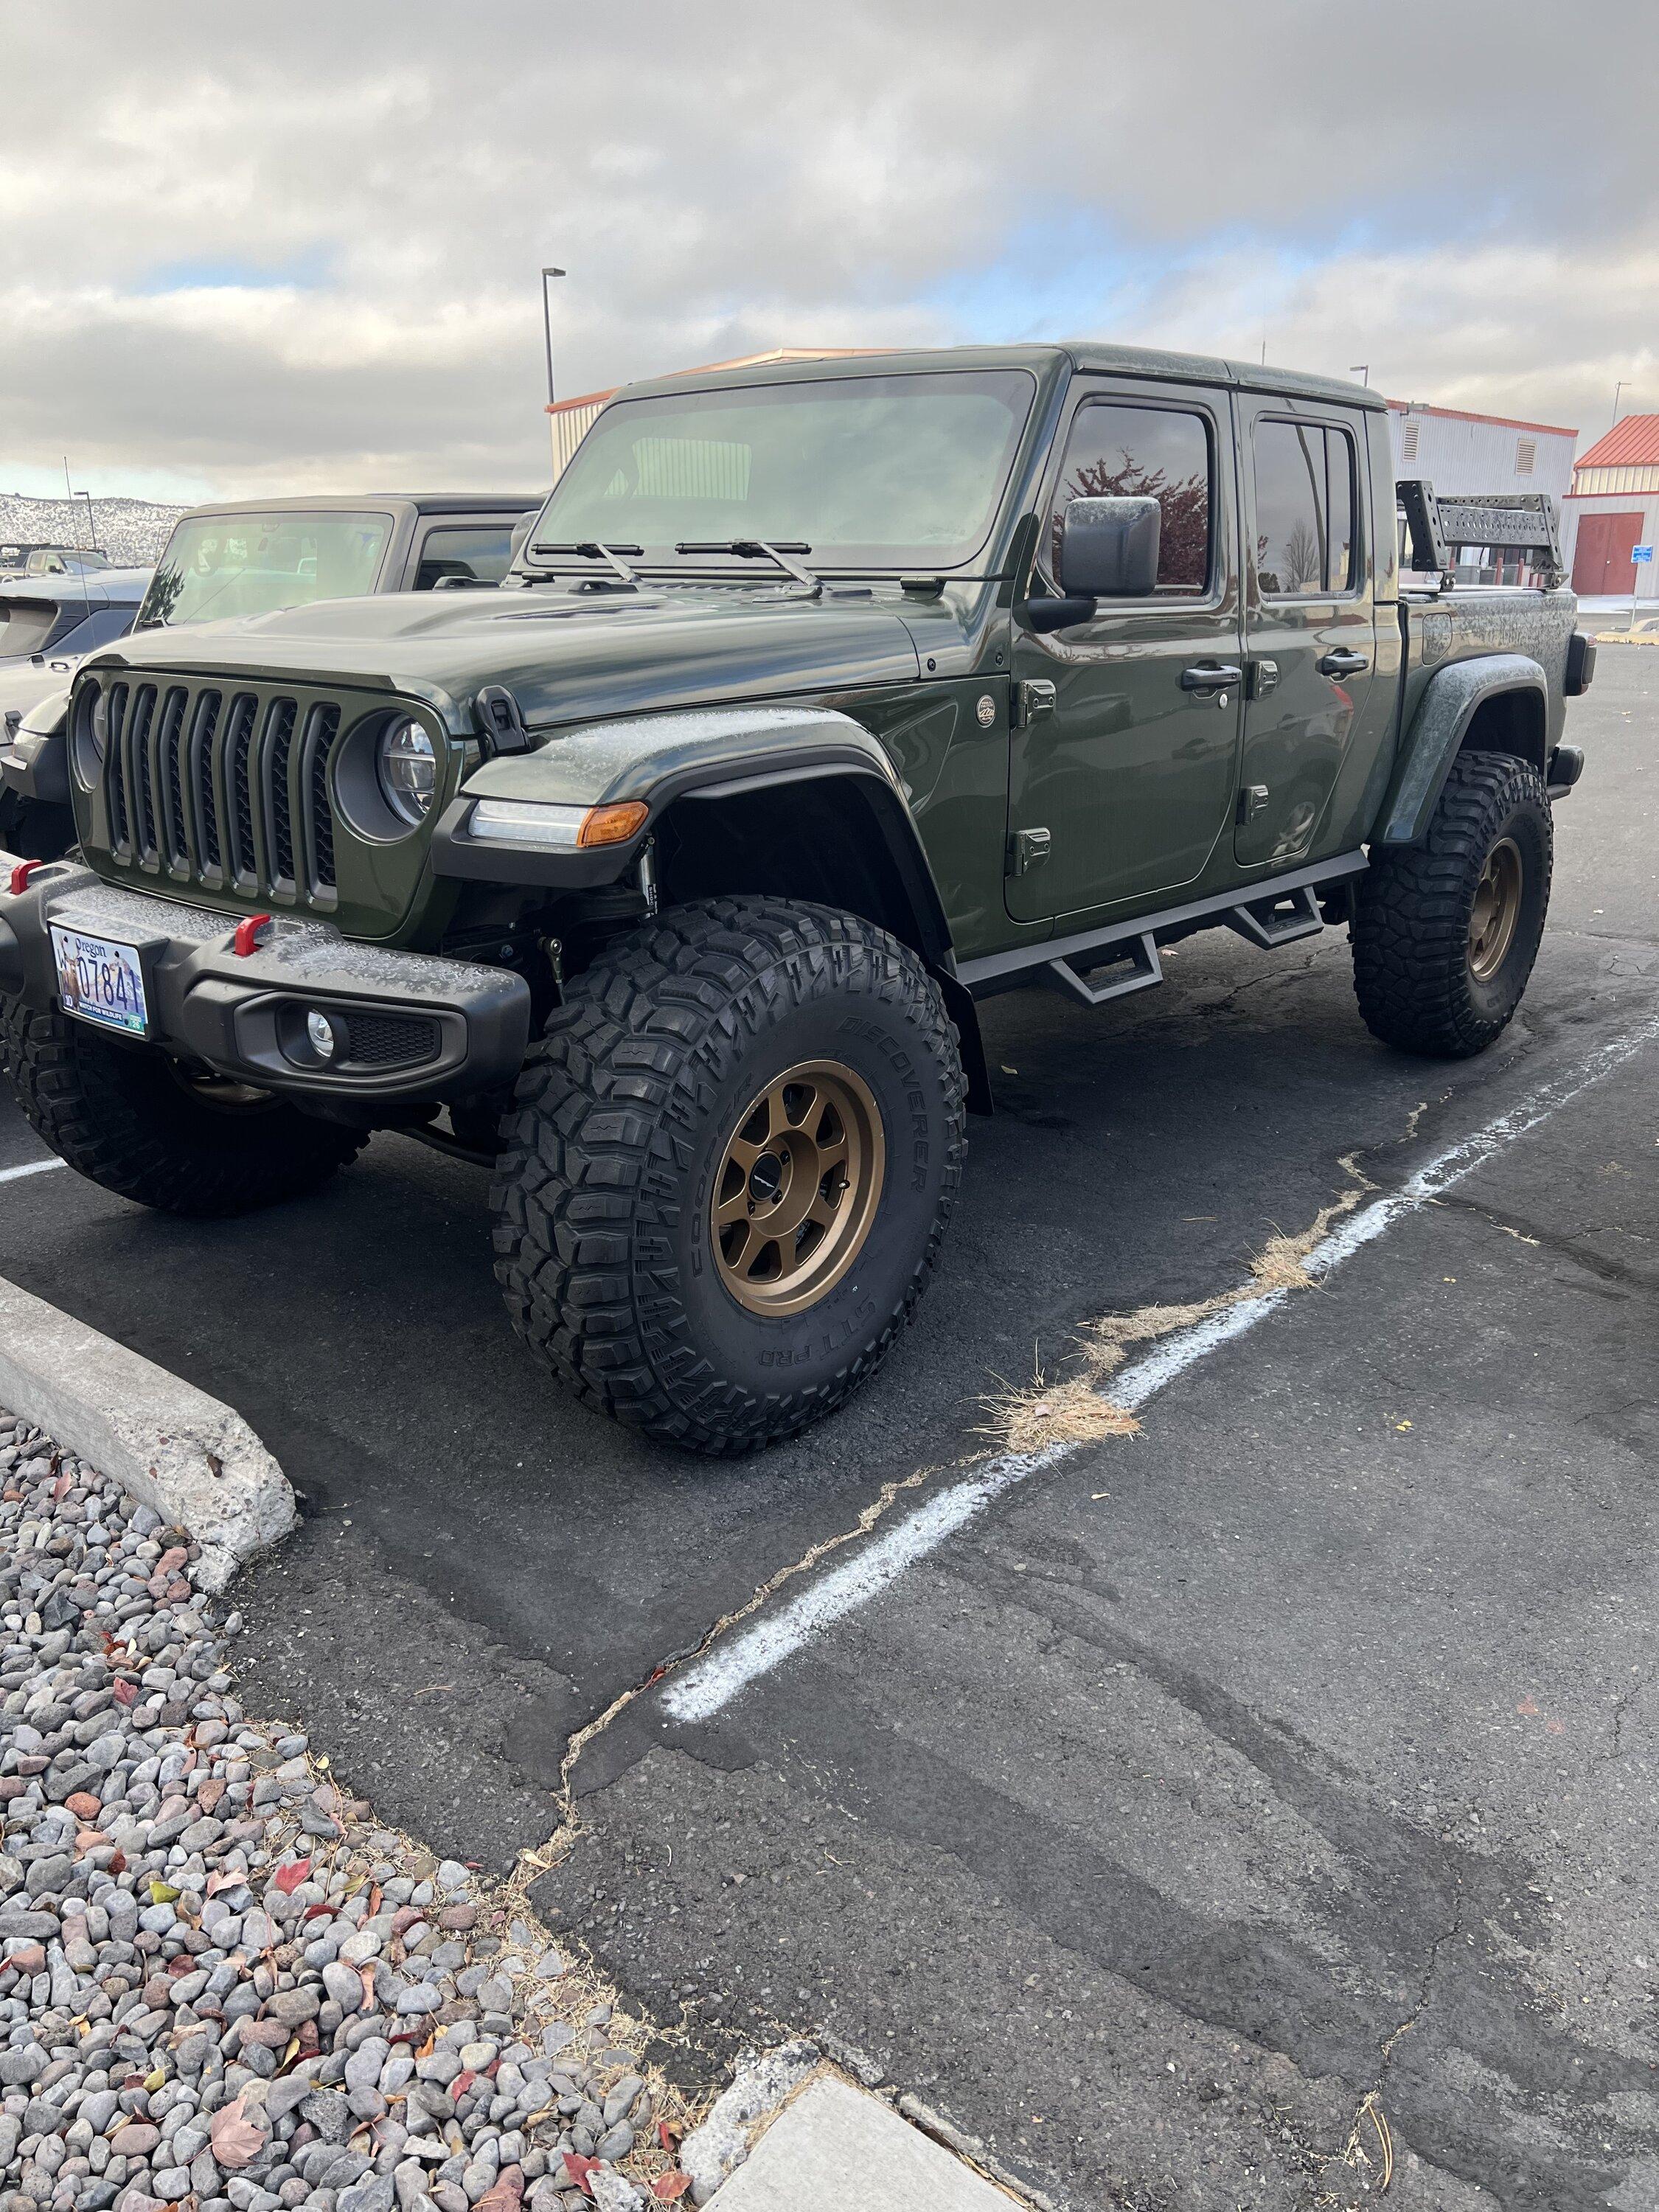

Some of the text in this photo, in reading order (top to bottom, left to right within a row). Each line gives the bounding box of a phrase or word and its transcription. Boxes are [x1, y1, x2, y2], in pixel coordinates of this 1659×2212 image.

[76, 938, 106, 958] Oregon
[77, 956, 139, 1013] 07841
[102, 1009, 122, 1020] WILDLIFE
[836, 1016, 929, 1193] DISCOVERER
[758, 1344, 811, 1368] PRO
